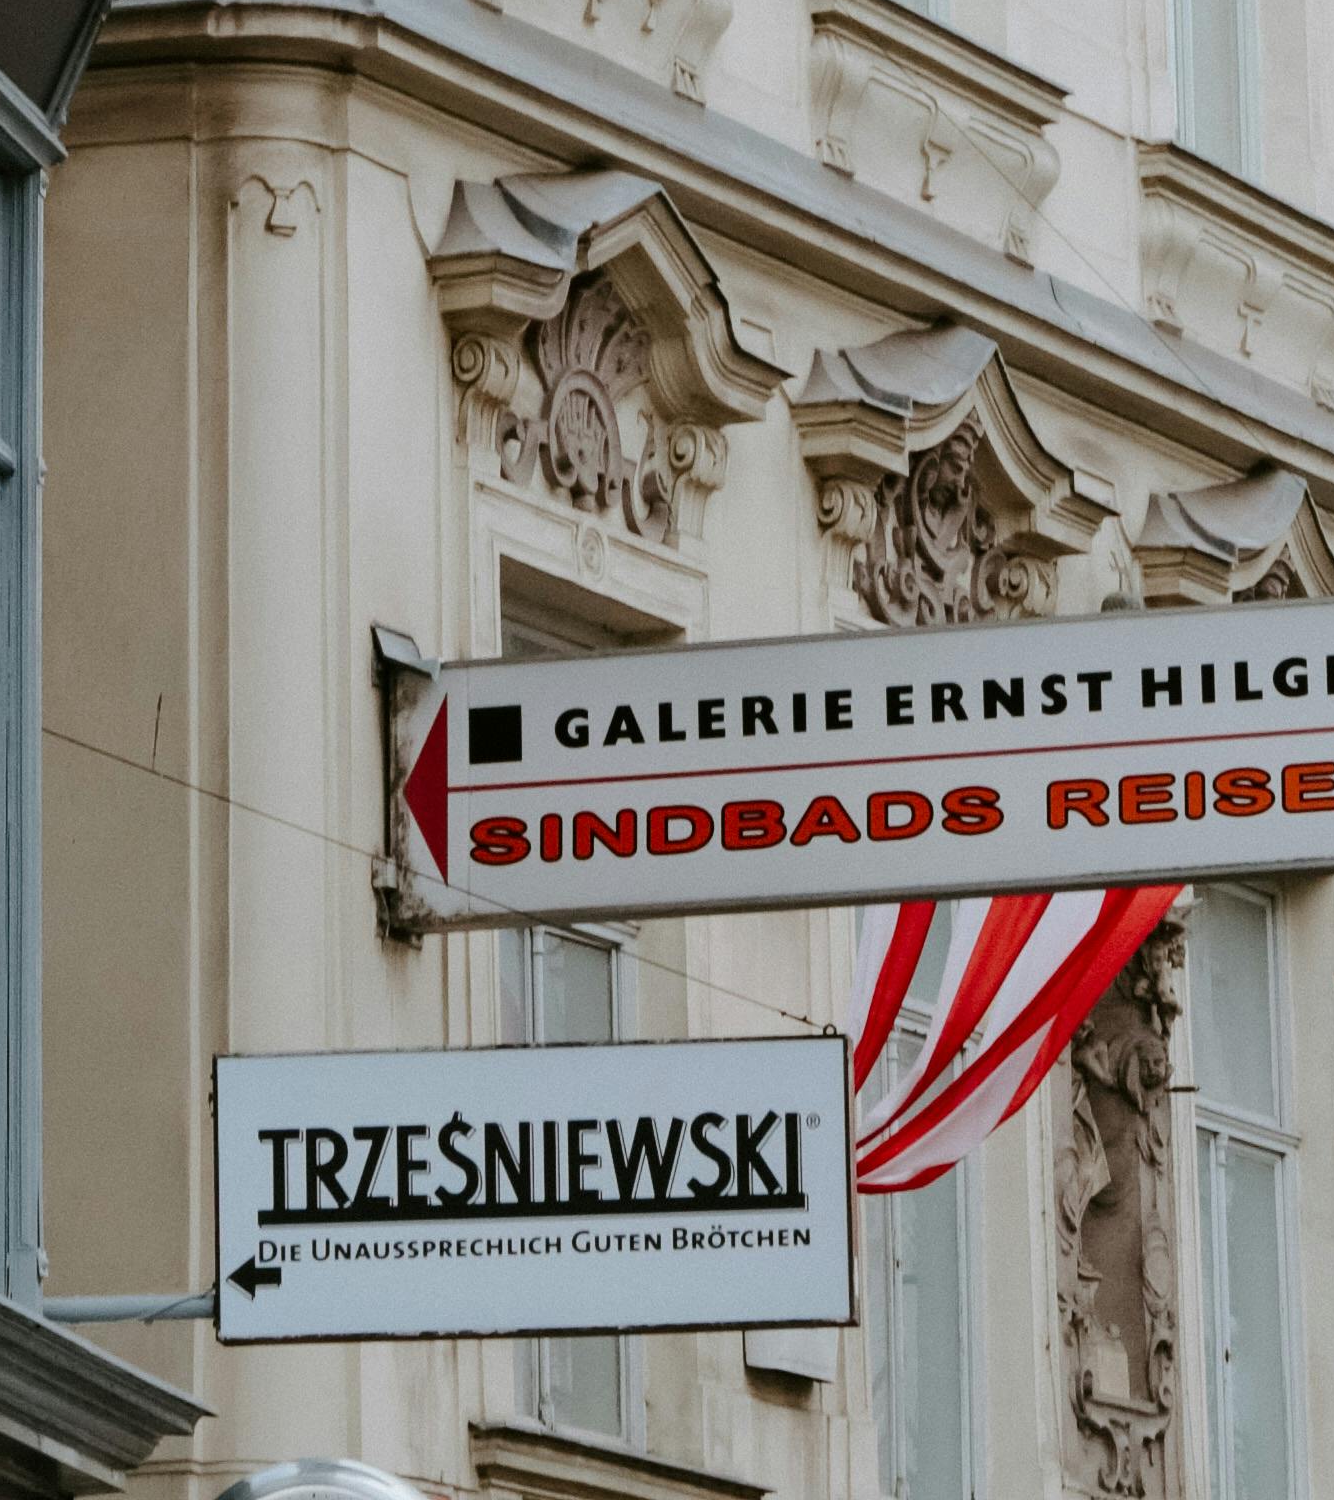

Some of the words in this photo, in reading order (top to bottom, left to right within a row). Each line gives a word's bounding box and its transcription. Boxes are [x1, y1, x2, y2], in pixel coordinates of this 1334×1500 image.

[555, 690, 854, 748] GALERIE
[885, 671, 1113, 727] ERNST
[468, 786, 1004, 866] SINDBADS
